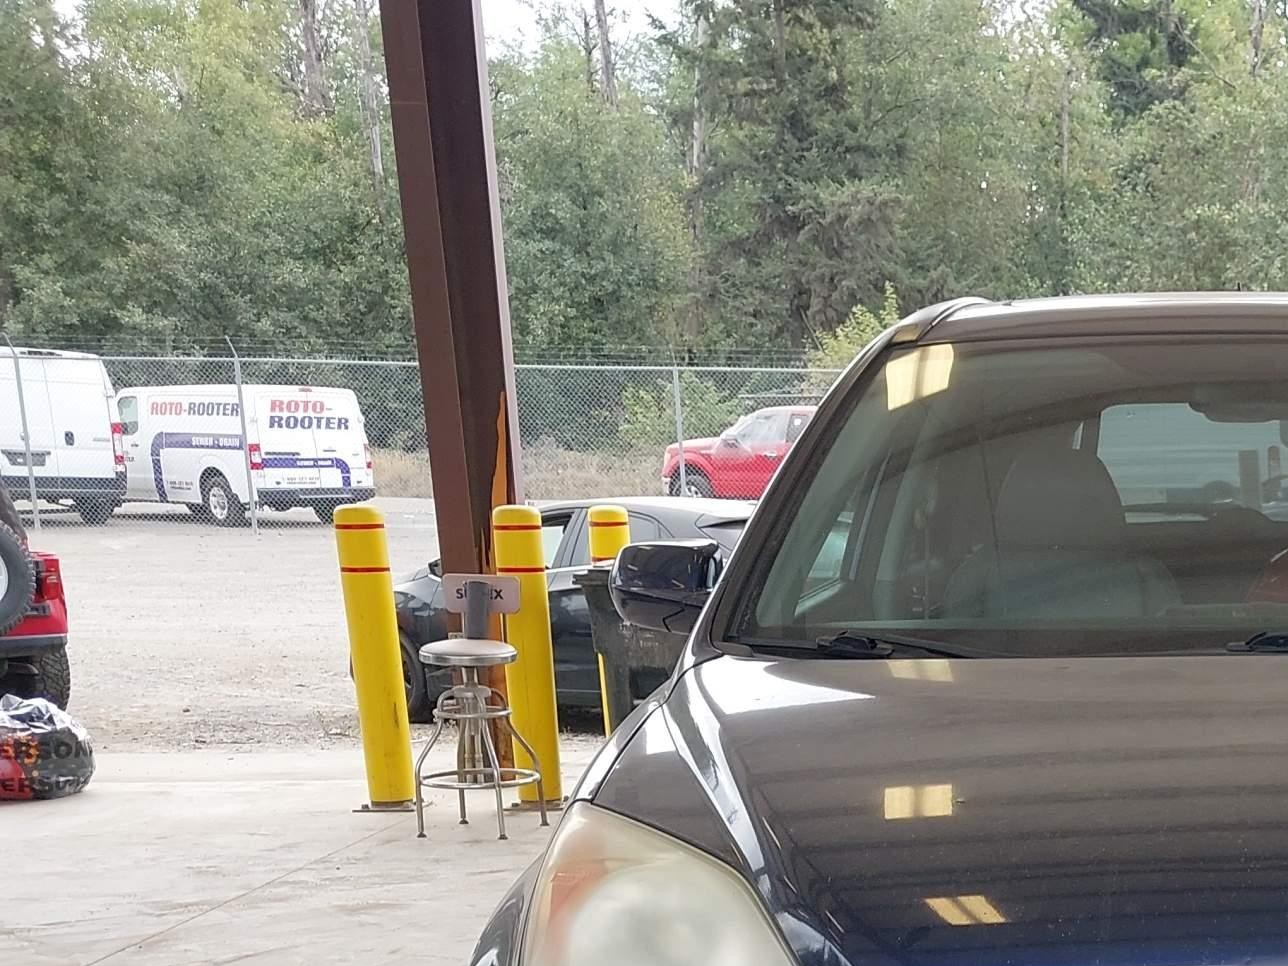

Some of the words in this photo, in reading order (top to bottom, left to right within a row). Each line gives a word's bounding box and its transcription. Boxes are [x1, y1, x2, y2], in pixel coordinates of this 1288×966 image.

[150, 402, 240, 417] ROTO-ROOTER
[270, 399, 333, 414] ROTO-
[268, 415, 349, 430] ROOTER
